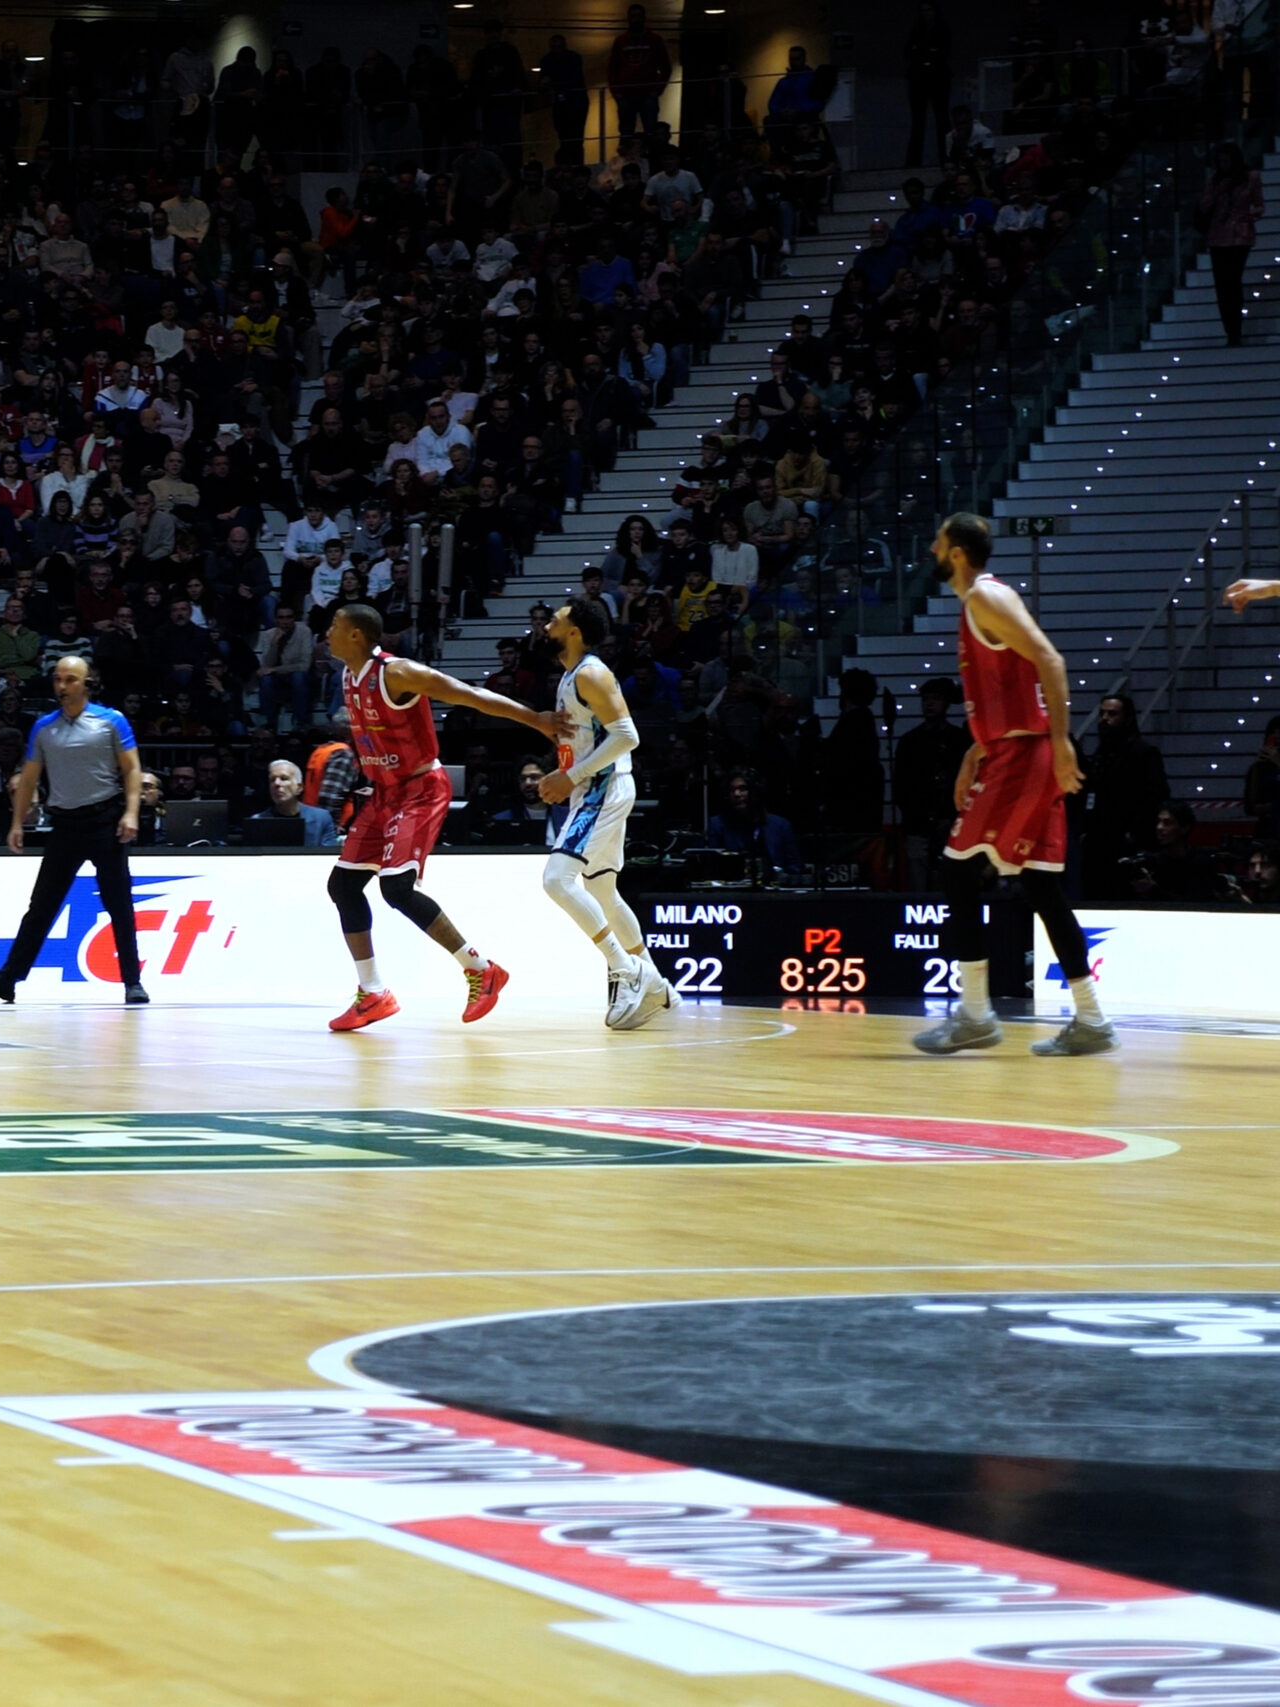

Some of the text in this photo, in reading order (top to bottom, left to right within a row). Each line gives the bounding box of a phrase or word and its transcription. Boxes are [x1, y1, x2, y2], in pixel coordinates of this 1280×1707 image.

[655, 904, 743, 925] MILANO
[646, 932, 734, 951] FALLI 1
[804, 928, 843, 954] P2
[894, 934, 940, 950] FALLI
[673, 957, 724, 992] 22
[779, 957, 867, 993] 8:25
